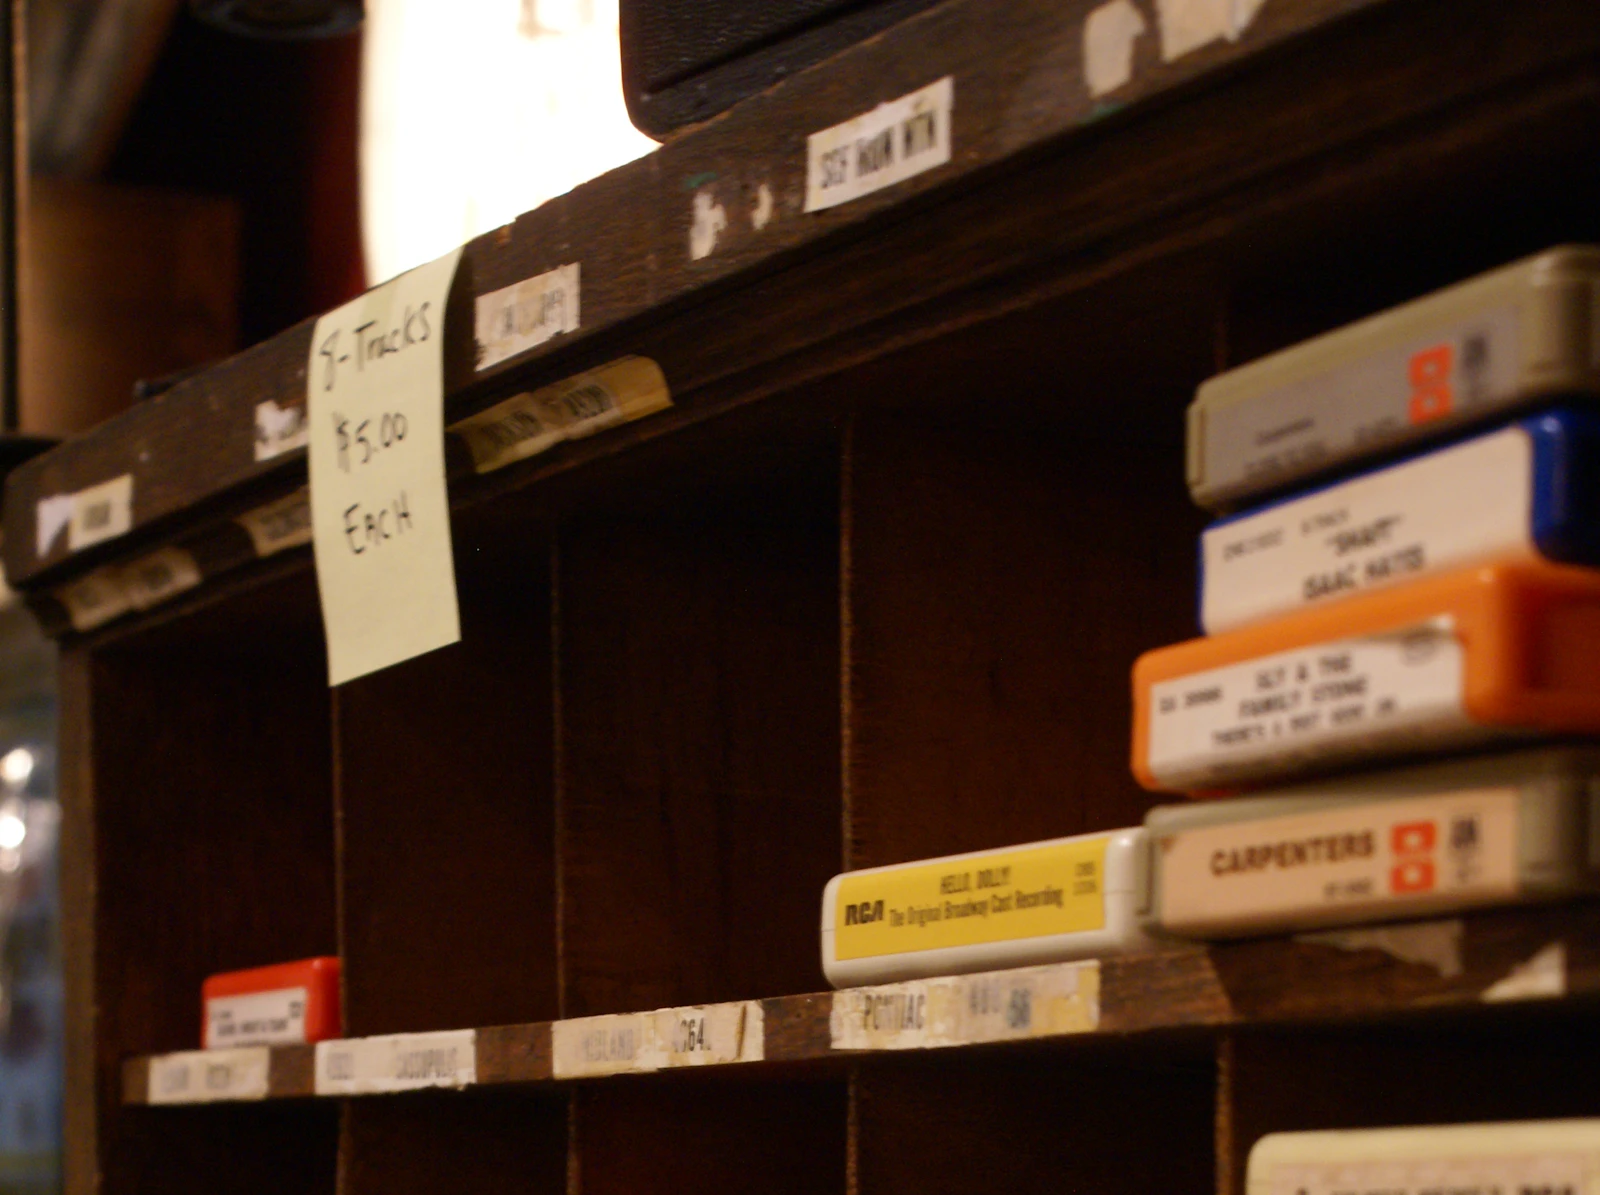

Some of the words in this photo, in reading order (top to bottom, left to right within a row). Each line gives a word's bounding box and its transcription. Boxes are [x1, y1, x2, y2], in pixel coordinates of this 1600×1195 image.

[331, 411, 408, 473] $5.00
[1210, 830, 1376, 876] CARPENTERS
[845, 900, 884, 926] RCA
